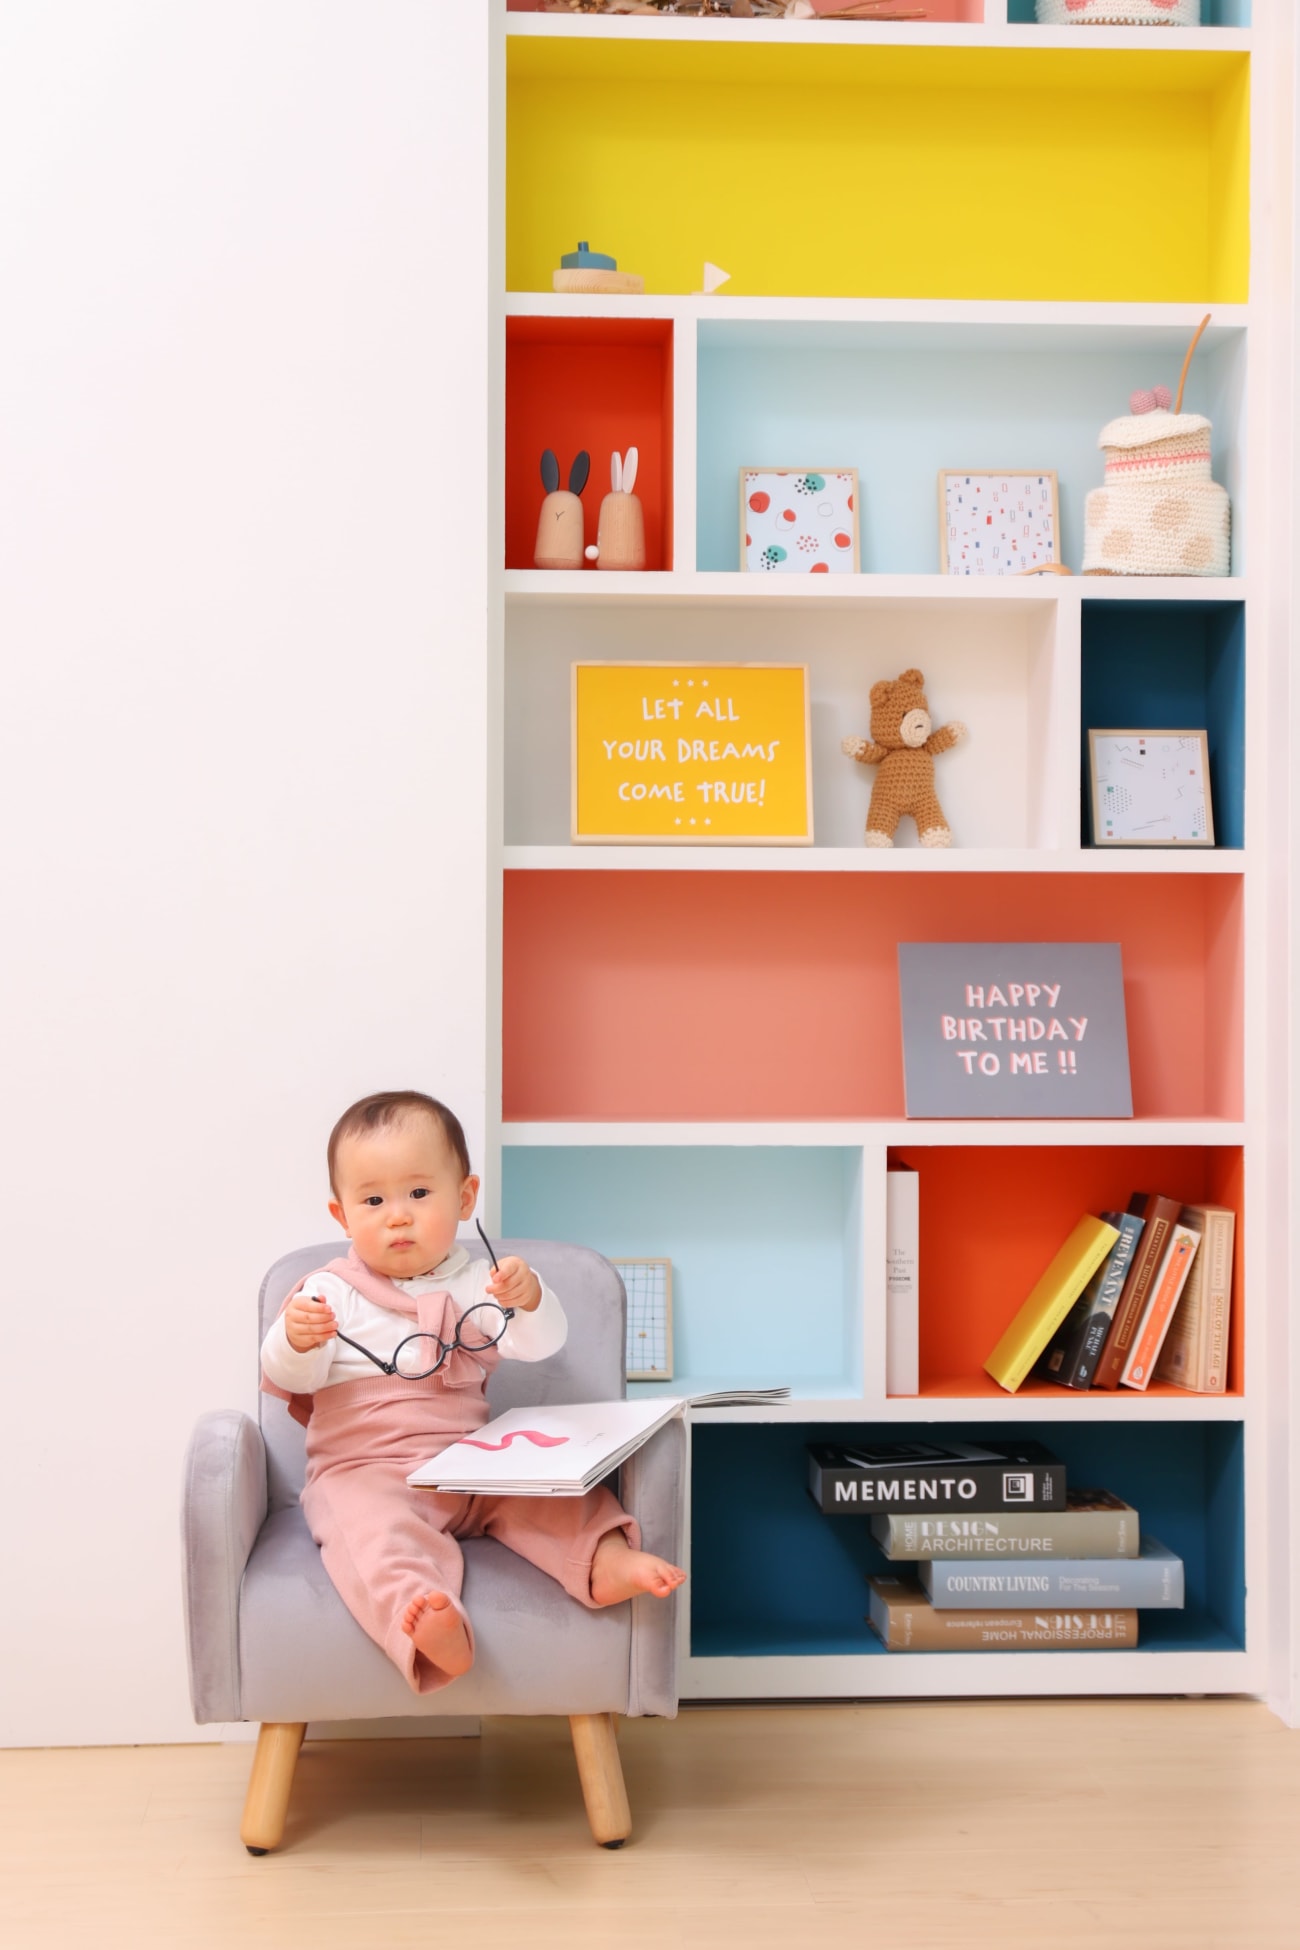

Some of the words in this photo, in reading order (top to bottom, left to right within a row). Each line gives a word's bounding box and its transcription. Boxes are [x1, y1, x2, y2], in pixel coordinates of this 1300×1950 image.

[642, 697, 684, 721] LET
[696, 697, 740, 721] ALL
[603, 739, 666, 761] YOUR
[677, 738, 780, 763] DREAMS
[618, 782, 685, 802] COME
[696, 779, 766, 807] TRUE!
[965, 983, 1061, 1009] HAPPY
[941, 1015, 1089, 1042] BIRTHDAY
[957, 1051, 1001, 1076] TO
[1010, 1052, 1049, 1075] ME
[1058, 1050, 1077, 1075] !!
[1101, 1233, 1134, 1306] REVENANT
[1215, 1295, 1224, 1318] SOUL
[1089, 1327, 1105, 1356] MICHAEL
[835, 1478, 978, 1502] MEMENTO
[904, 1520, 914, 1551] HOME
[921, 1520, 999, 1537] DESIGN
[921, 1538, 1054, 1551] ARCHITECTURE
[947, 1576, 1006, 1592] COUNTRY
[1007, 1576, 1050, 1592] LIVING
[1034, 1613, 1112, 1630] DESIGN
[982, 1630, 1017, 1641] HOME
[1021, 1628, 1113, 1640] PROFESSIONAL
